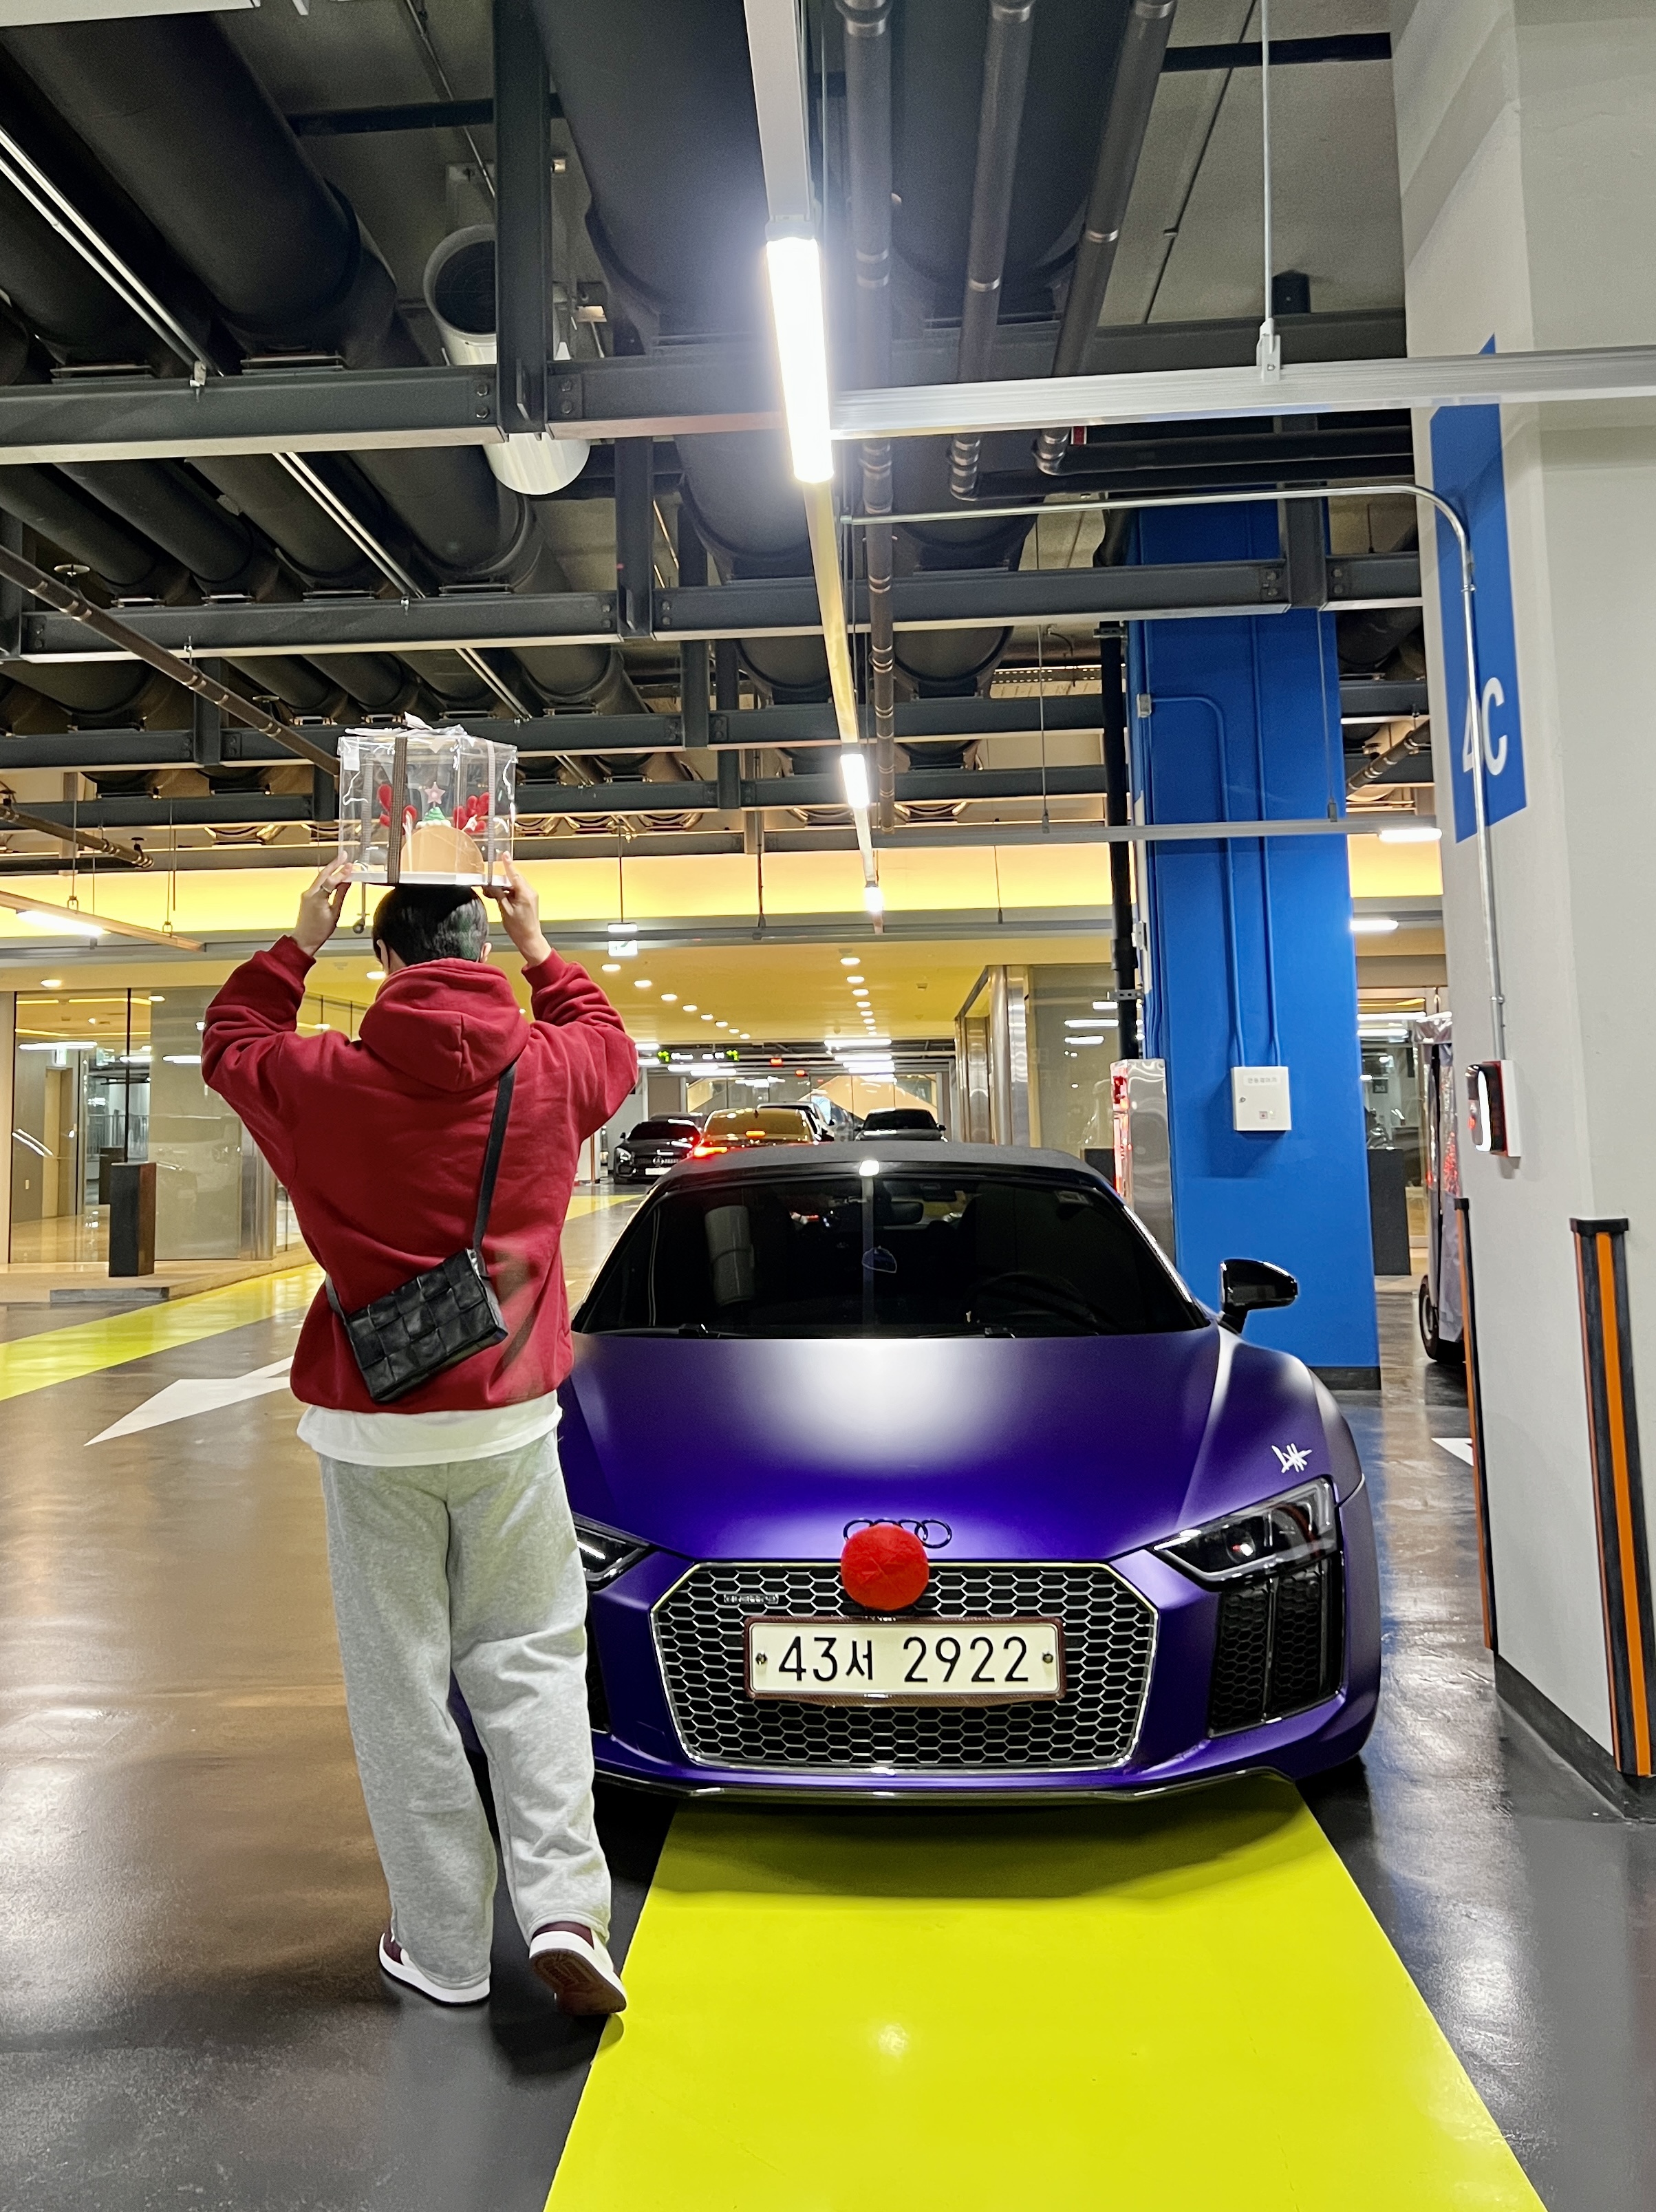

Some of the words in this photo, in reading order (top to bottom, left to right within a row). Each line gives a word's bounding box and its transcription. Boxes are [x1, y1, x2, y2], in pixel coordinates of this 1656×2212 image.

[1462, 676, 1508, 776] 4C
[778, 1635, 874, 1682] 43서
[903, 1636, 1029, 1683] 2922
